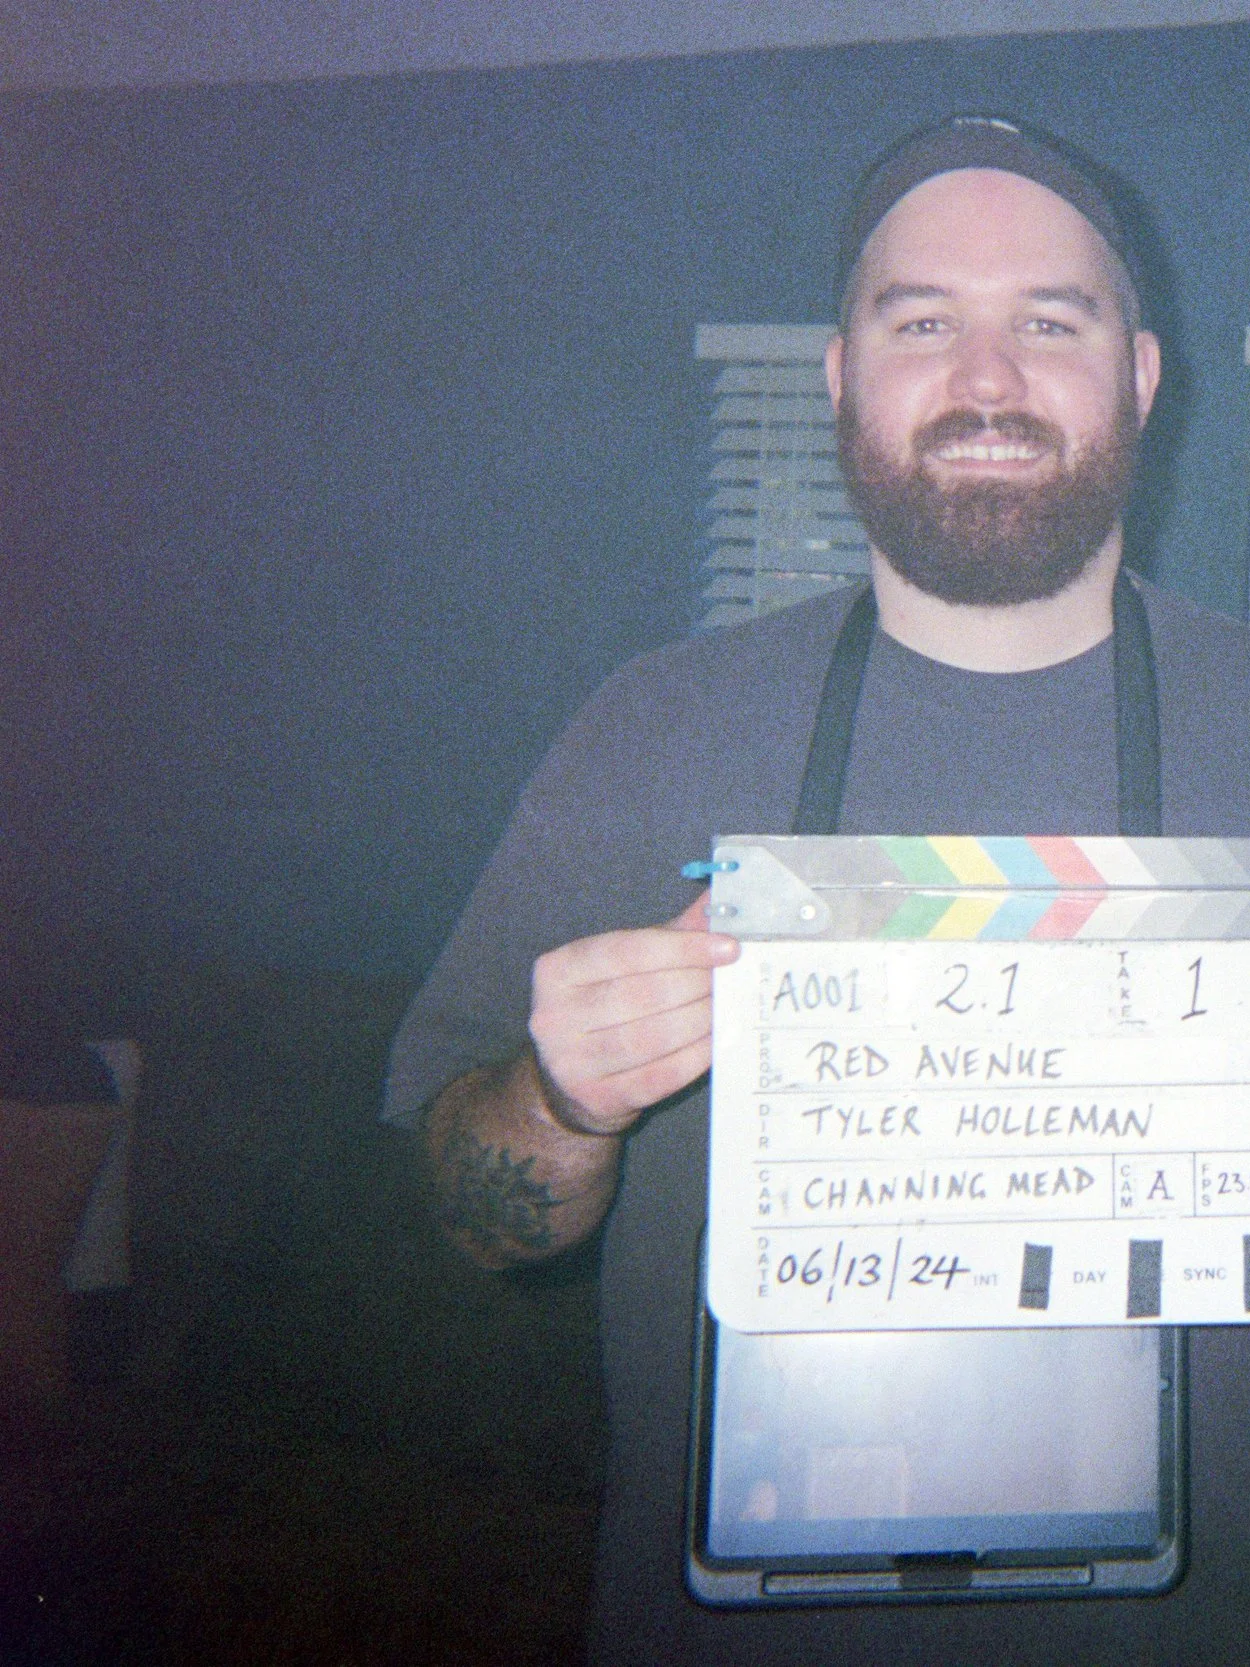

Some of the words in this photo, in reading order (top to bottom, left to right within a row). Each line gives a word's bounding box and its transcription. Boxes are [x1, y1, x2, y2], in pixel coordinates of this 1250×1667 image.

[772, 967, 863, 1014] A001
[935, 961, 1020, 1016] 2.1
[1117, 951, 1133, 1018] TAKE
[1180, 956, 1208, 1021] 1
[758, 1032, 771, 1090] PROD
[806, 1040, 890, 1082] RED
[915, 1042, 1067, 1081] AVENUE
[758, 1103, 771, 1149] DIR
[801, 1104, 922, 1139] TYLER
[955, 1103, 1154, 1138] HOLLEMAN
[758, 1169, 772, 1216] CAM
[803, 1168, 988, 1210] CHANNING
[1006, 1165, 1096, 1198] MEAD
[1119, 1164, 1134, 1209] CAM
[1146, 1169, 1176, 1201] A
[1201, 1163, 1212, 1208] FPS
[758, 1236, 770, 1298] DATE
[776, 1236, 971, 1304] 06/13/24
[973, 1272, 998, 1287] INT
[1072, 1270, 1108, 1285] DAY
[1182, 1266, 1228, 1281] SYNC
